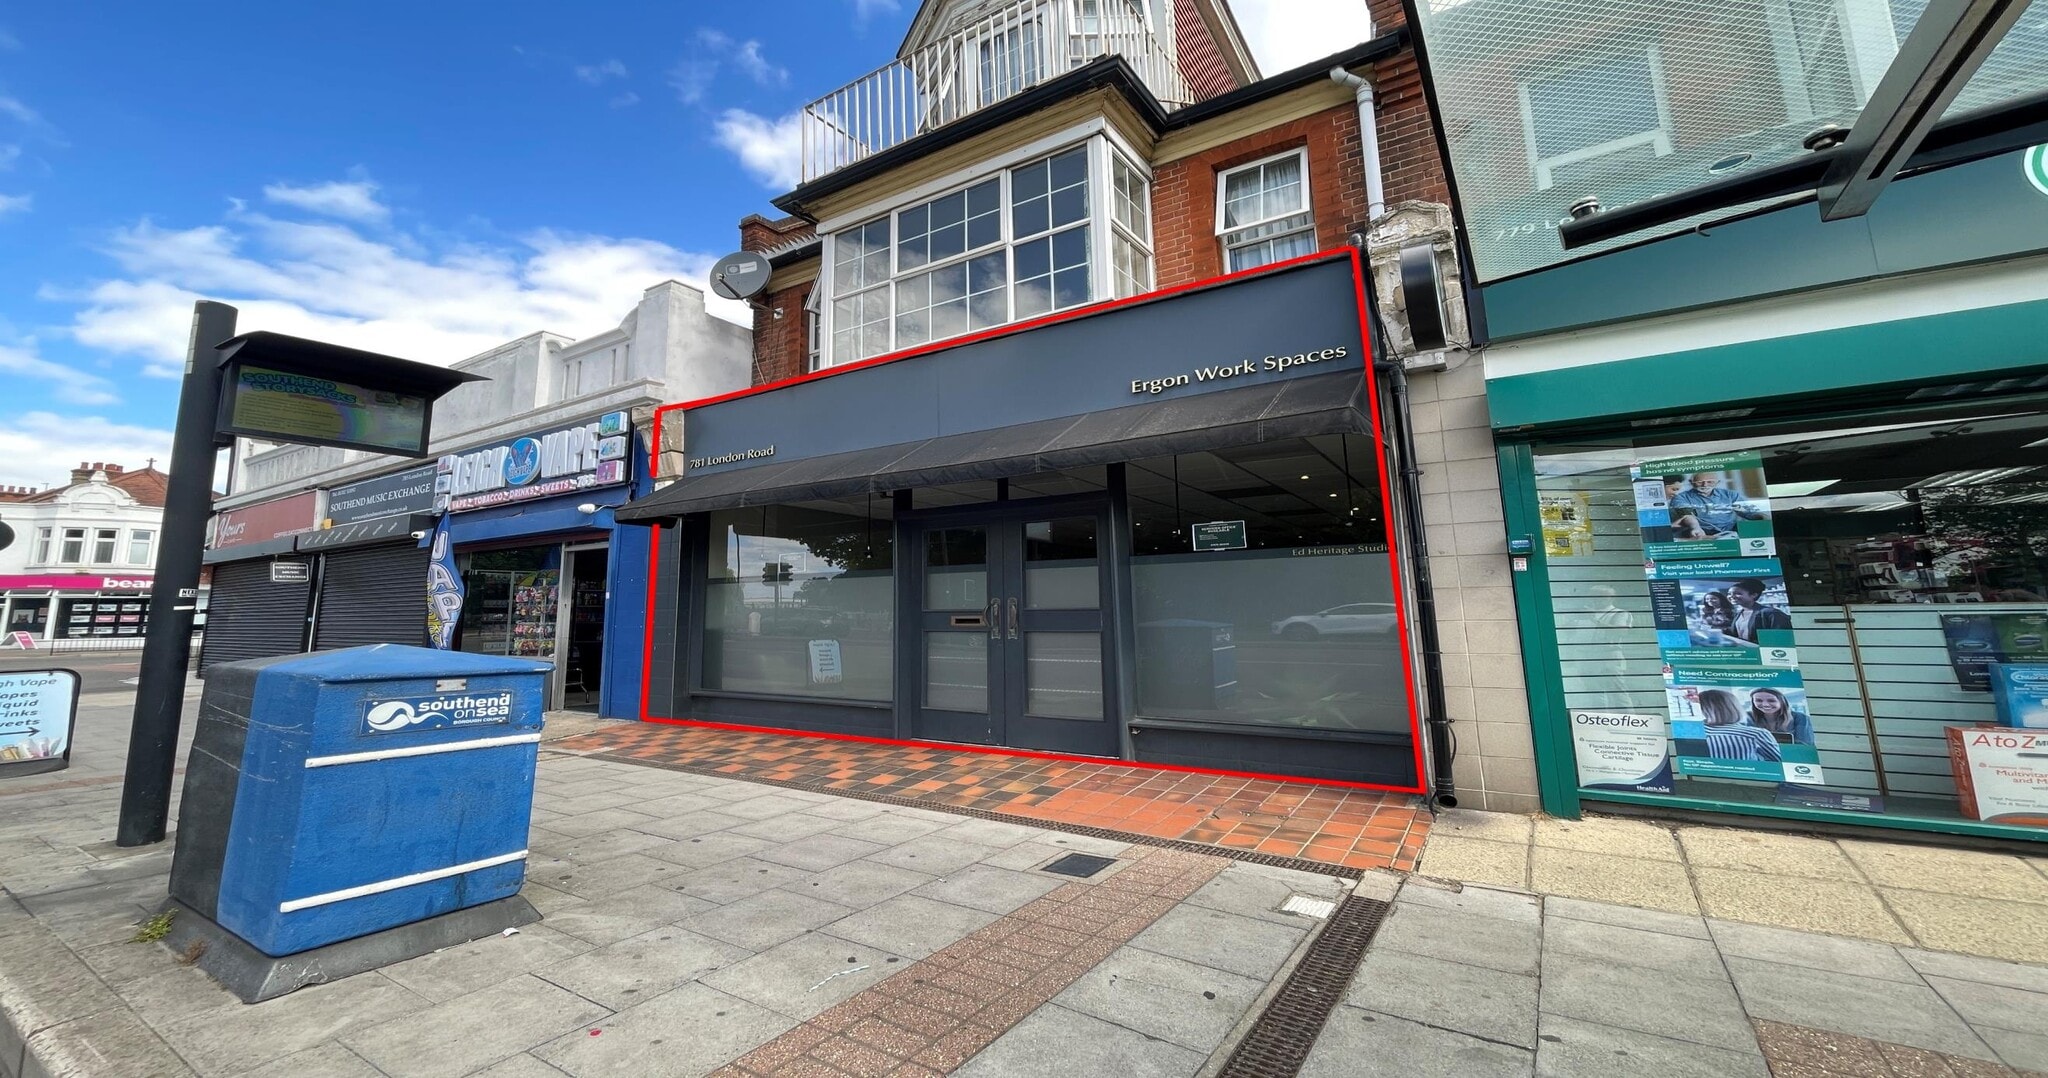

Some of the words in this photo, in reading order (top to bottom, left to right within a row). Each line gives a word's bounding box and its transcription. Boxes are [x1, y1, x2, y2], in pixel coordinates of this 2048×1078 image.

[1131, 374, 1189, 394] Ergon
[1194, 359, 1256, 381] Work
[1264, 346, 1347, 371] Spaces
[242, 372, 337, 391] SOUTHEND
[252, 383, 356, 403] STORYSACKS
[451, 446, 509, 496] LEIGH
[541, 422, 601, 479] VAPE
[690, 458, 705, 469] 781
[707, 451, 745, 467] London
[747, 445, 775, 459] Road
[1695, 457, 1735, 465] pressure
[1677, 464, 1725, 472] symptoms
[330, 498, 366, 513] SOUTHEND
[366, 492, 388, 506] MUSIC
[388, 483, 431, 500] EXCHANGE
[452, 498, 467, 510] VAPE
[474, 493, 504, 506] TOBACCO
[509, 488, 535, 500] DRINKS
[540, 480, 569, 494] SWEETS
[1308, 546, 1354, 555] Heritage
[102, 577, 154, 588] bear
[1705, 670, 1779, 678] Contraception?
[20, 679, 57, 687] Vape
[0, 692, 38, 700] apes
[418, 693, 510, 712] southend
[1576, 714, 1648, 728] Osteoflex
